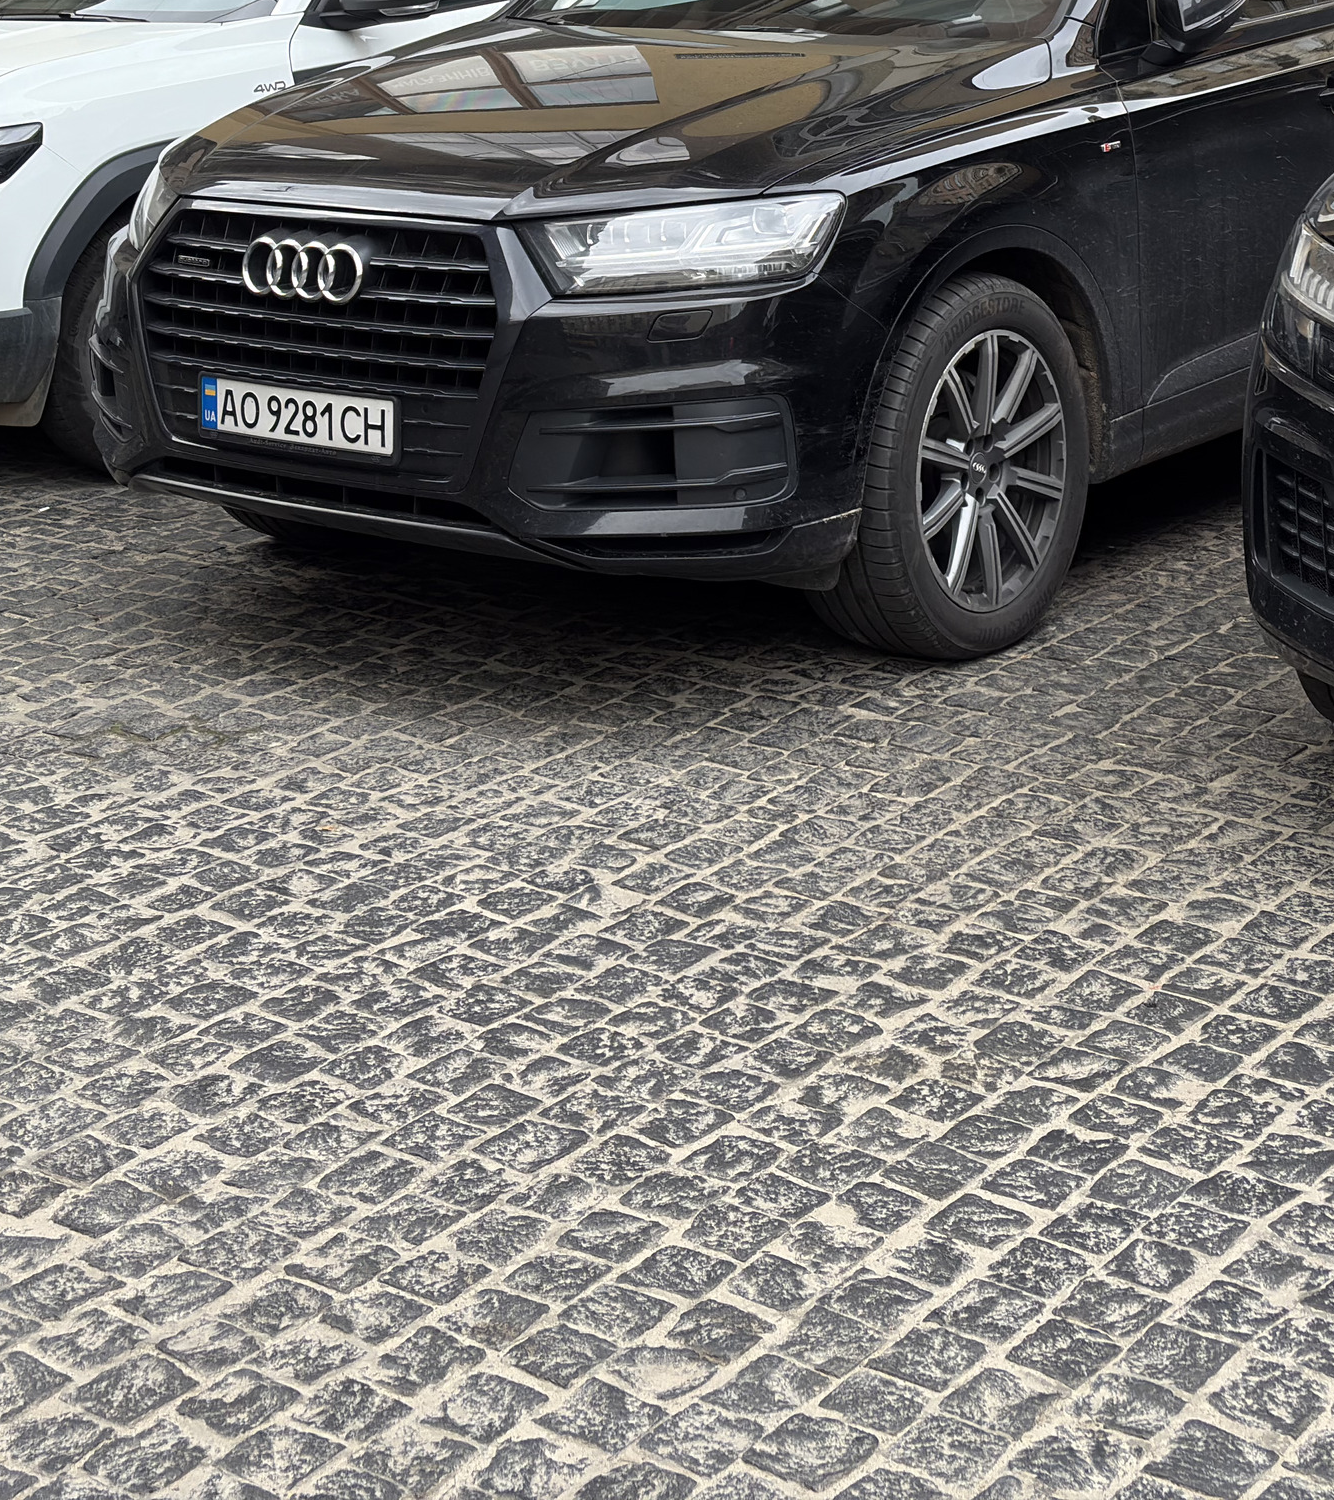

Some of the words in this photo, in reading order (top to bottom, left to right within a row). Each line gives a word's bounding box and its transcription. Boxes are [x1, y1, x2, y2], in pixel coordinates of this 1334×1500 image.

[253, 80, 286, 93] 4WD
[204, 410, 216, 422] UA
[220, 389, 260, 429] AO
[267, 395, 334, 441] 9281
[340, 405, 386, 448] CH
